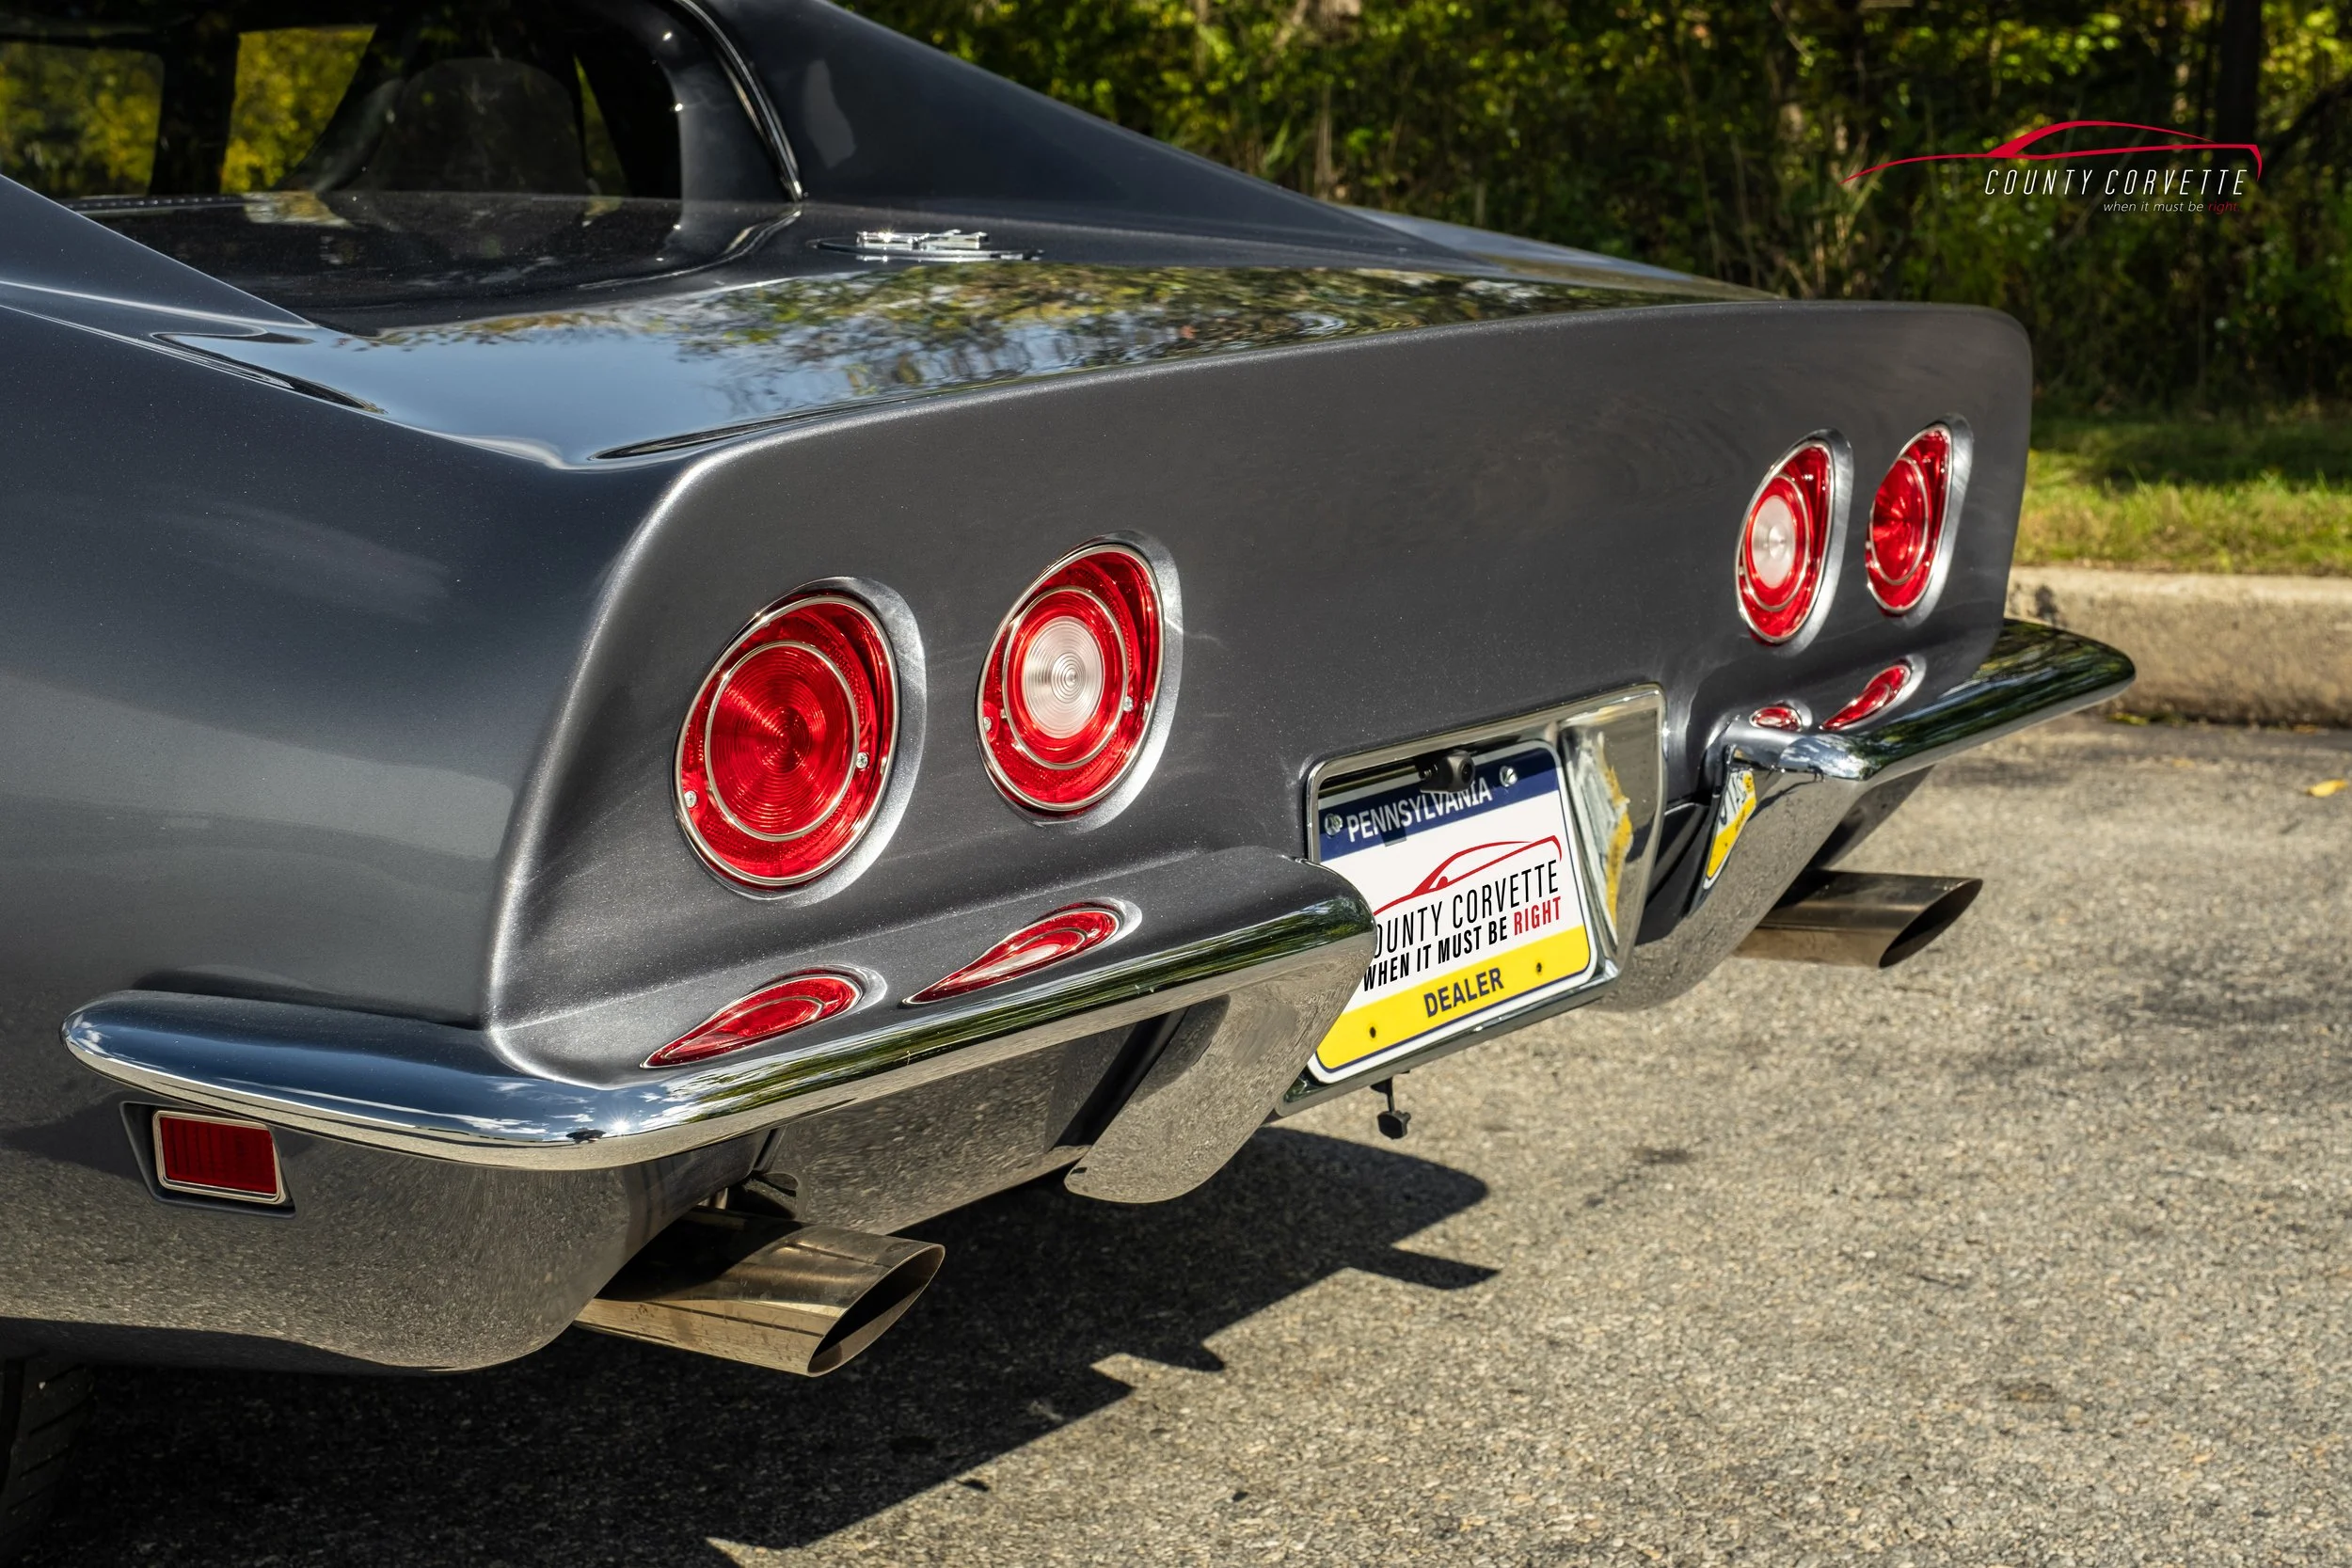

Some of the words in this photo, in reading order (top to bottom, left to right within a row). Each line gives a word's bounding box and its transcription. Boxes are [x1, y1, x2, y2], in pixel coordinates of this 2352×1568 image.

[1346, 777, 1493, 842] PENNSYLVANIA
[1363, 952, 1409, 991] WHEN
[1417, 943, 1432, 973] IT
[1438, 926, 1482, 965] MUST
[1488, 916, 1507, 945] BE
[1514, 896, 1562, 935] RIGHT
[1374, 901, 1443, 958] OUNTY
[1453, 859, 1559, 928] CORVETTE
[1423, 967, 1504, 1018] DEALER
